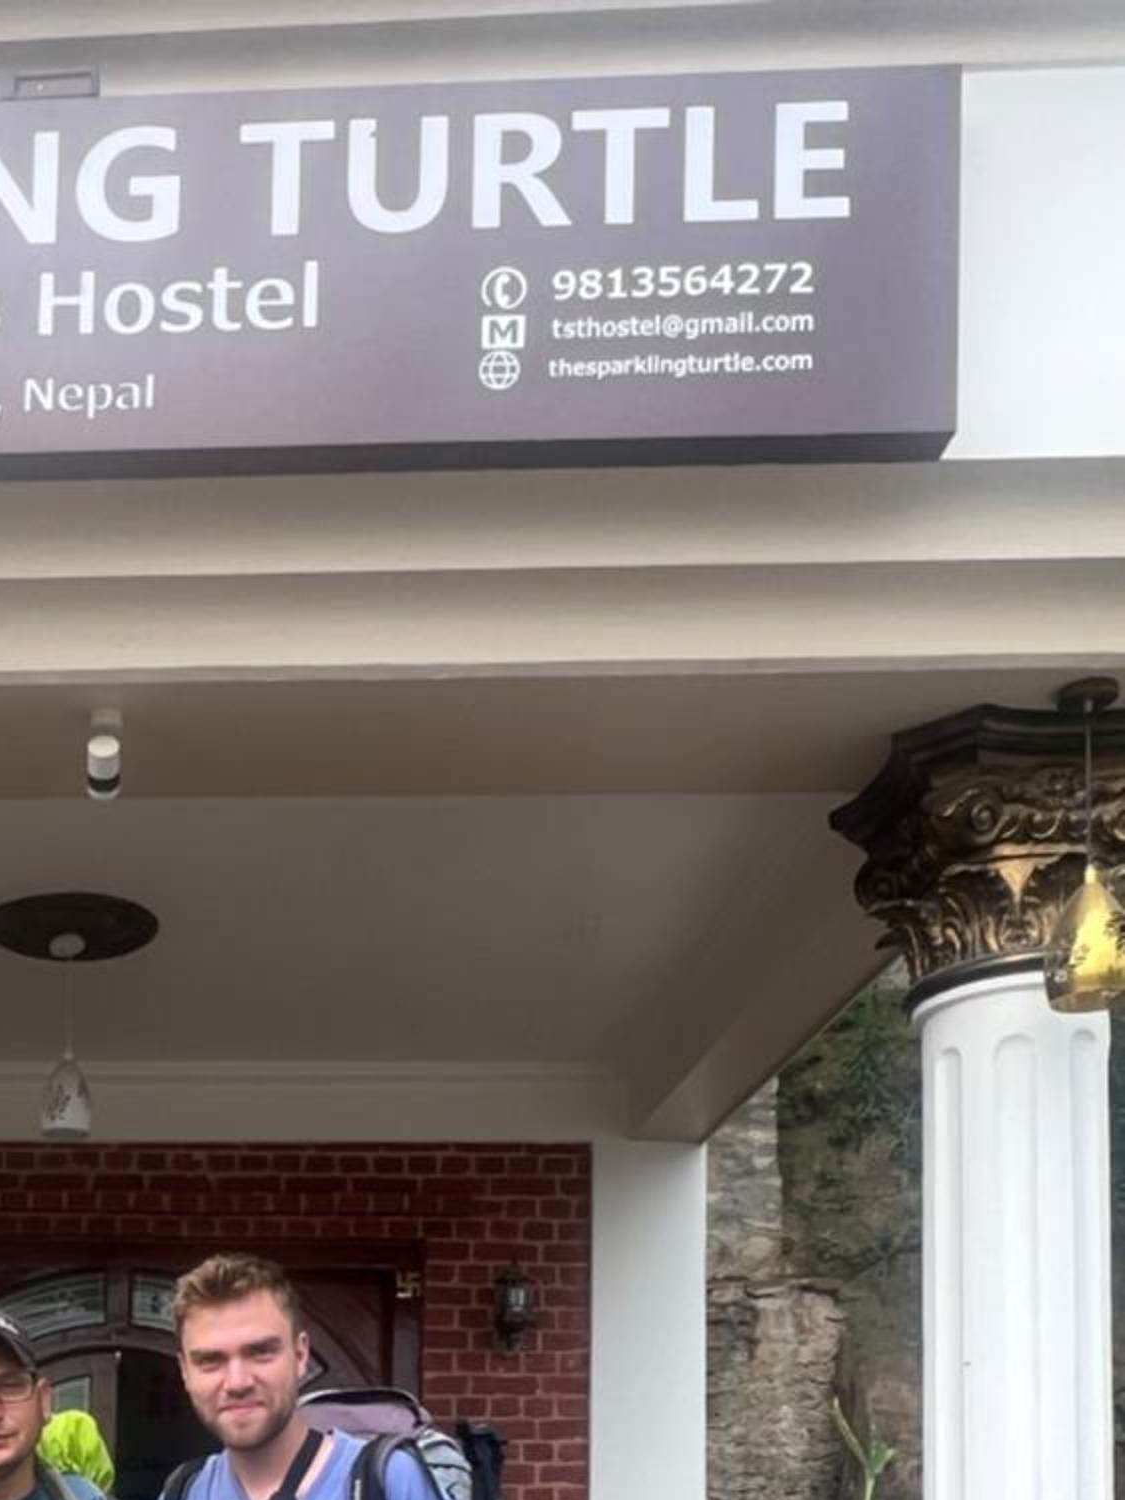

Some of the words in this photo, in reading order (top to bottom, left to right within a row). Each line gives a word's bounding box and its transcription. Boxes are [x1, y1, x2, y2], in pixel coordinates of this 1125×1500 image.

[240, 100, 851, 236] TURTLE
[38, 260, 319, 336] Hostel
[552, 262, 815, 301] 9813564272
[552, 311, 815, 340] tsthostel@gmail.com
[548, 352, 814, 380] thesparklingturtle.com
[24, 374, 155, 419] Nepal
